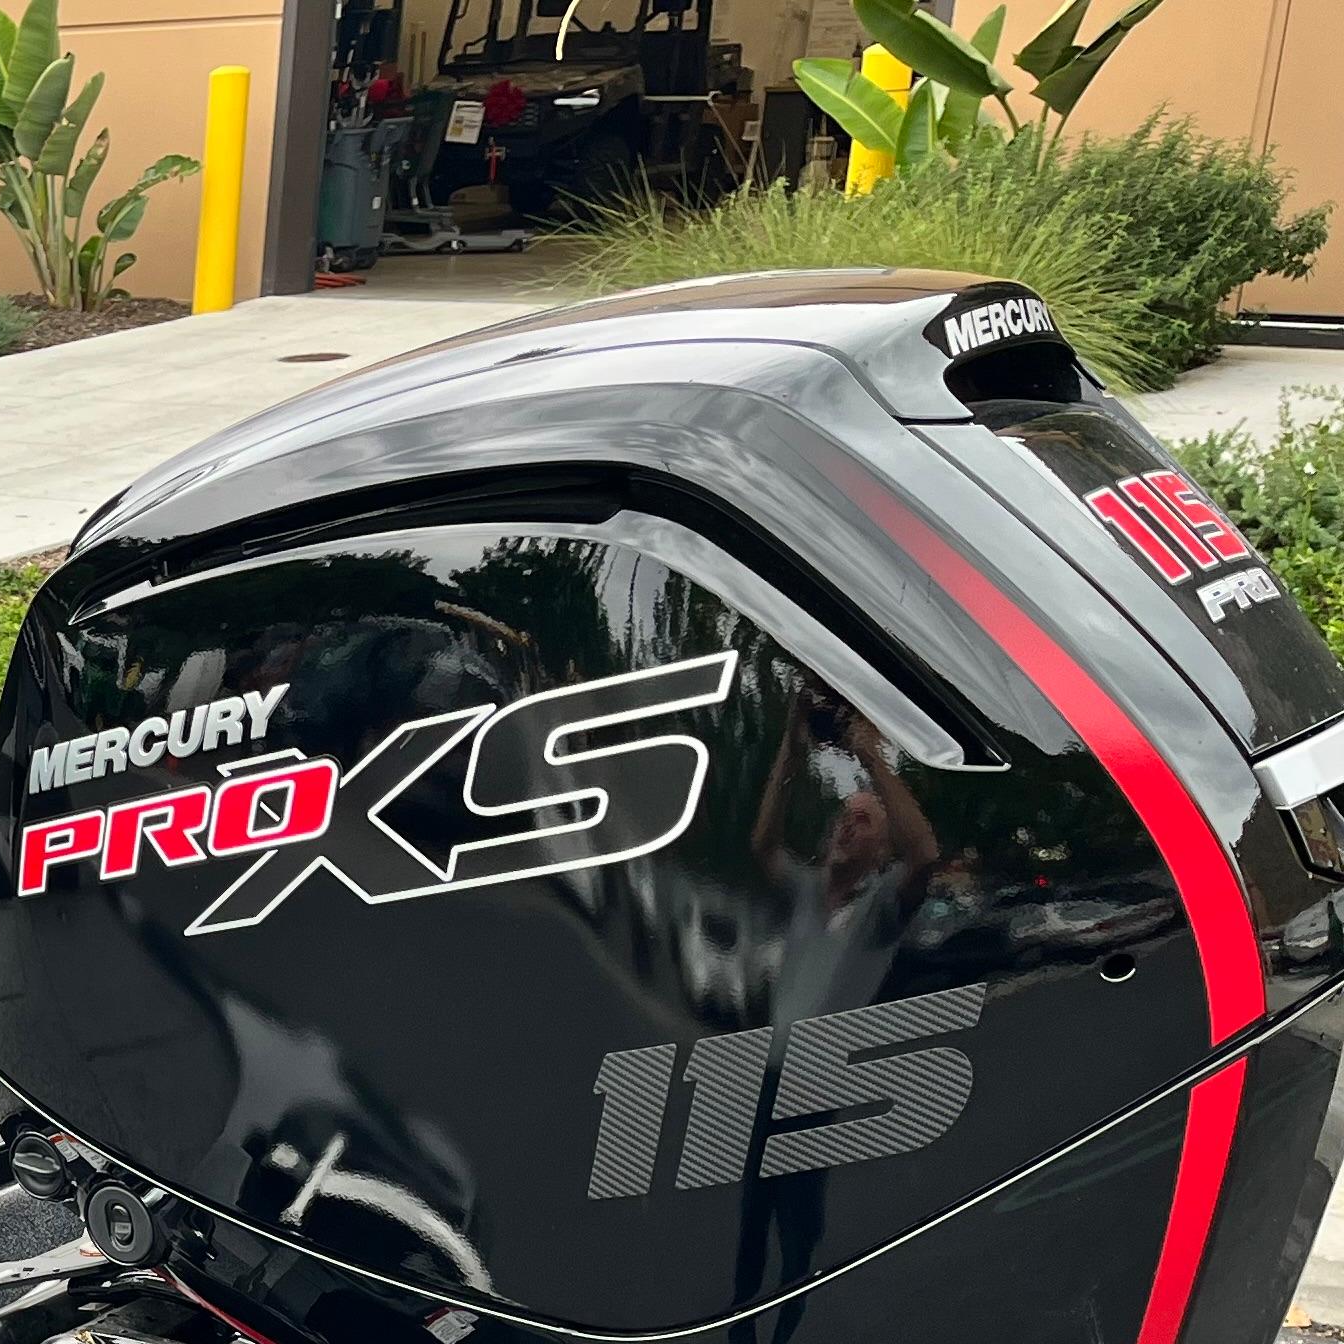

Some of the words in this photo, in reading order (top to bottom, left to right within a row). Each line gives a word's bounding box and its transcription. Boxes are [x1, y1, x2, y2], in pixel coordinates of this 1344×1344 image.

[944, 299, 1054, 358] MERCURY
[1084, 469, 1252, 586] 115
[1196, 567, 1282, 624] PRO
[17, 754, 341, 899] PRO
[183, 648, 739, 939] XS
[28, 683, 290, 795] MERCURY
[586, 981, 988, 1199] 115
